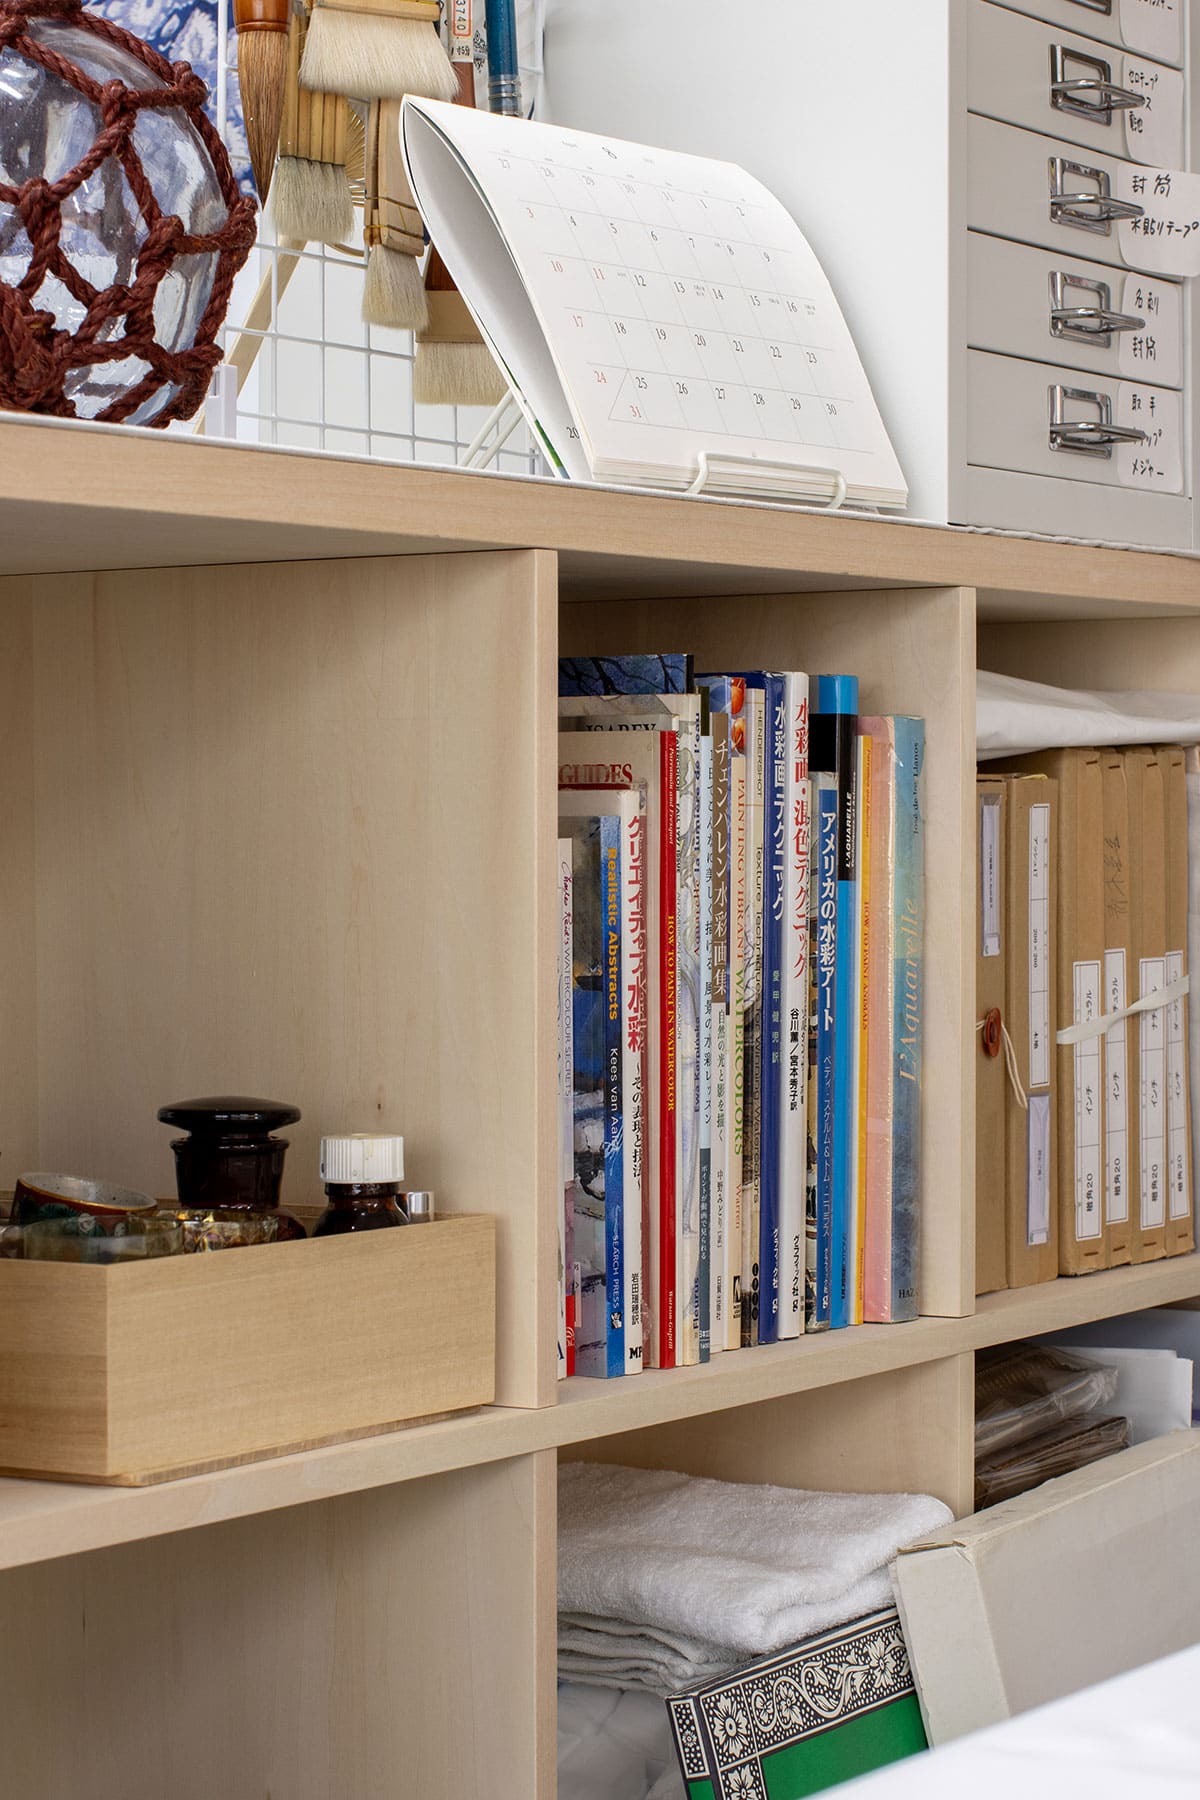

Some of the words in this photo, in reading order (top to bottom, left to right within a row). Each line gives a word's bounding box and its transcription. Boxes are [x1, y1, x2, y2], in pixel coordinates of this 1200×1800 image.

[526, 207, 534, 218] 3
[570, 215, 577, 226] 4
[610, 223, 618, 234] 5
[650, 230, 658, 241] 6
[688, 238, 695, 248] 7
[726, 245, 734, 255] 8
[763, 252, 770, 262] 9
[550, 261, 563, 273] 10
[592, 268, 605, 280] 11
[634, 274, 646, 287] 12
[674, 281, 686, 294] 13
[712, 288, 724, 300] 14
[750, 295, 761, 307] 15
[786, 301, 797, 313] 16
[572, 315, 584, 328] 17
[614, 322, 627, 335] 18
[655, 328, 667, 340] 19
[695, 334, 706, 347] 20
[733, 340, 744, 353] 21
[770, 346, 782, 358] 22
[806, 352, 817, 364] 23
[594, 370, 607, 383] 24
[635, 376, 648, 389] 25
[676, 382, 688, 395] 26
[715, 388, 726, 400] 27
[753, 393, 765, 405] 28
[790, 398, 801, 410] 29
[826, 403, 837, 416] 30
[630, 405, 642, 418] 31
[737, 779, 745, 871] PAINTING
[772, 701, 785, 921] 水彩画テクニック
[793, 697, 809, 979] 水彩画・混色テクニック
[844, 791, 852, 868] L'AQUARELLE
[607, 848, 617, 926] Realistic
[736, 878, 744, 959] VIBRANT
[667, 915, 675, 946] HOW
[820, 811, 837, 1032] アメリカの水彩アート
[863, 932, 870, 946] TO
[608, 931, 619, 1020] Abstracts
[667, 949, 675, 968] TO
[667, 971, 675, 1006] PAINT
[754, 911, 762, 1002] Techniques
[900, 897, 920, 1081] L'Aquarelle
[564, 948, 572, 1044] WATERCOLOUR
[667, 1010, 675, 1024] IN
[565, 1047, 573, 1097] SECRETS
[610, 1048, 618, 1082] Kees
[667, 1027, 675, 1111] WATERCOLOR
[734, 970, 744, 1155] WATERCOLORS
[753, 1035, 761, 1100] Winning
[612, 1234, 620, 1276] SEARCH
